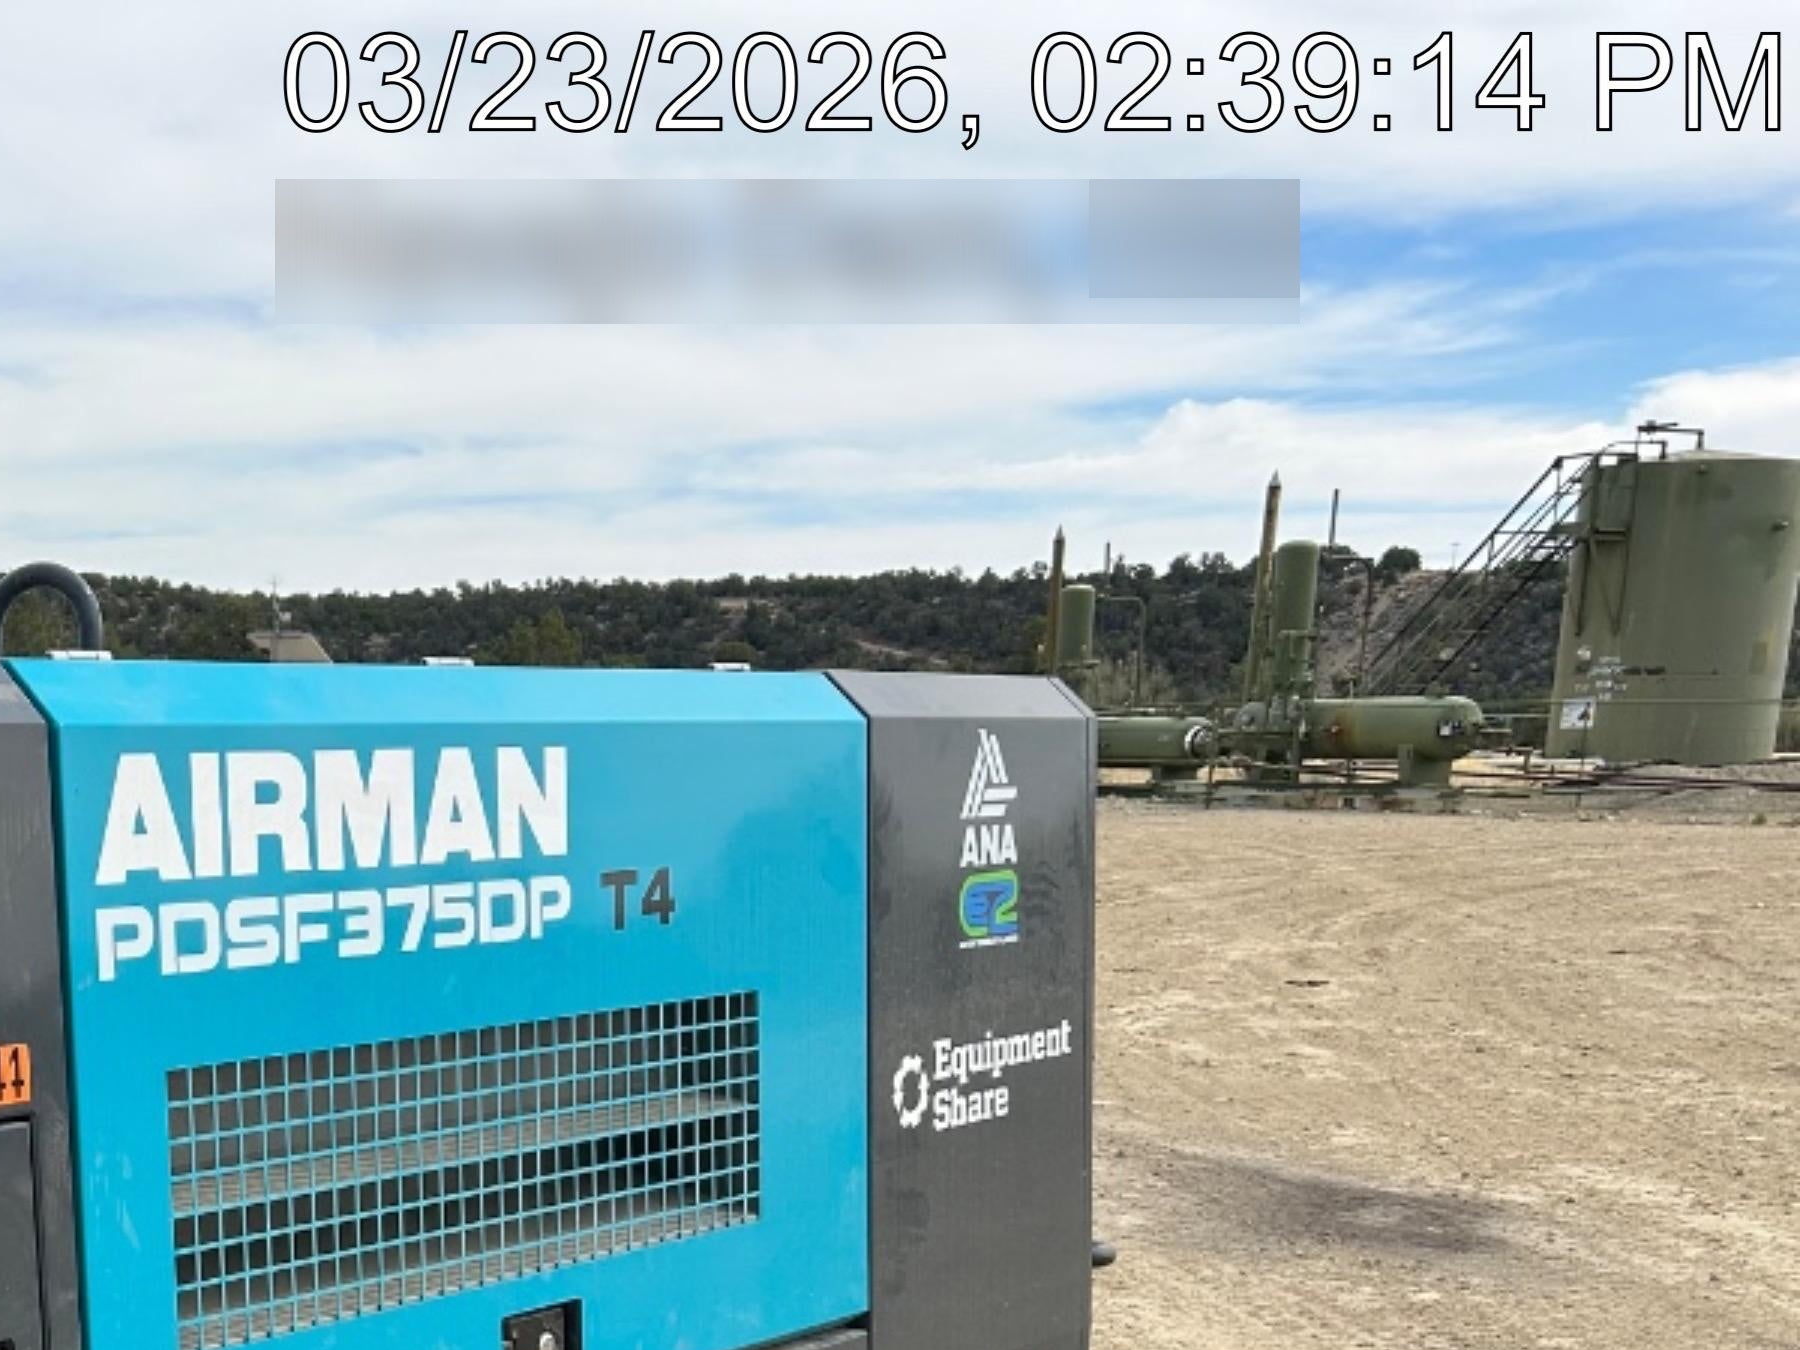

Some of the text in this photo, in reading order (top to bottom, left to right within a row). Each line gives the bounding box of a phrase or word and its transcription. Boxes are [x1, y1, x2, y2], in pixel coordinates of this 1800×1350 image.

[95, 746, 568, 886] AIRMAN
[959, 823, 1018, 868] ANA
[95, 866, 676, 982] PDSF375DP T4
[932, 1019, 1072, 1085] Equipment
[932, 1085, 1010, 1132] Share
